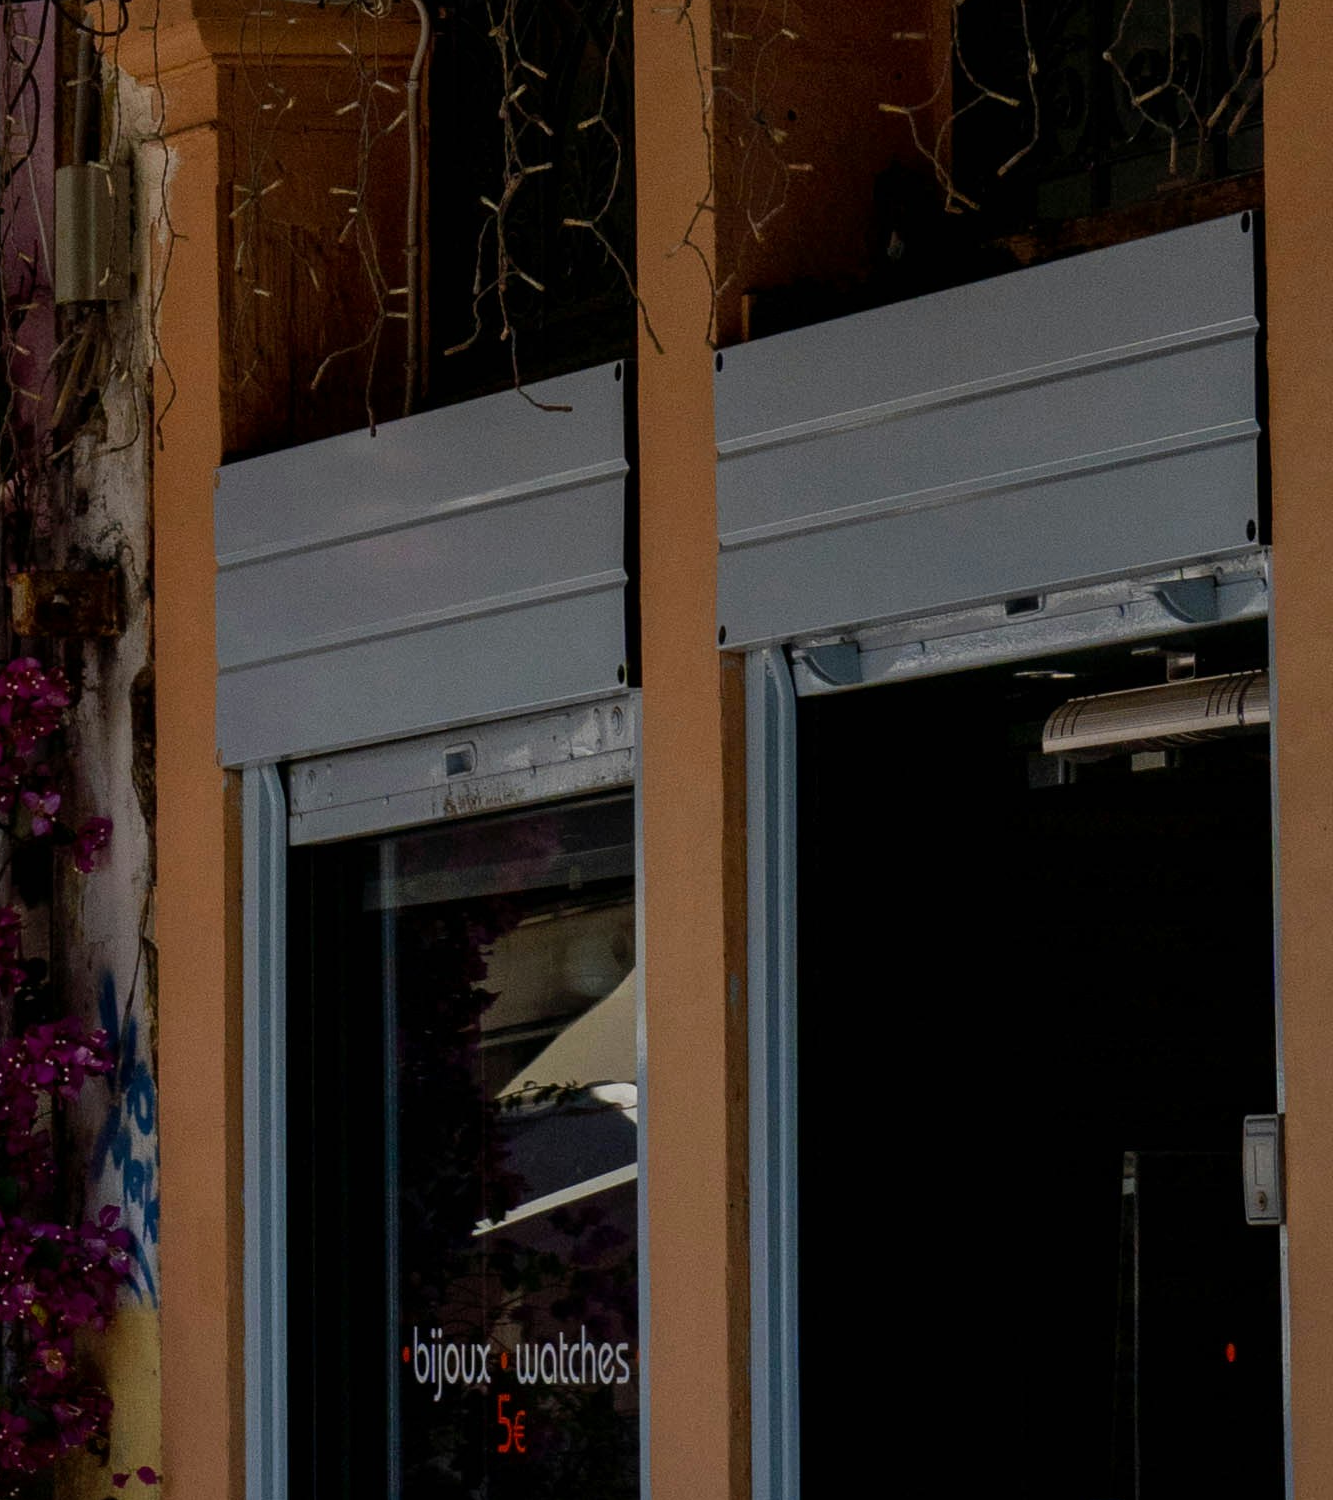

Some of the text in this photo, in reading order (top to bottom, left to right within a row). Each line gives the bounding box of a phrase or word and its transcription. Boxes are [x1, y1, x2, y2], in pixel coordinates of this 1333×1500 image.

[413, 1324, 631, 1403] bijoux watches
[496, 1393, 527, 1454] 5€
